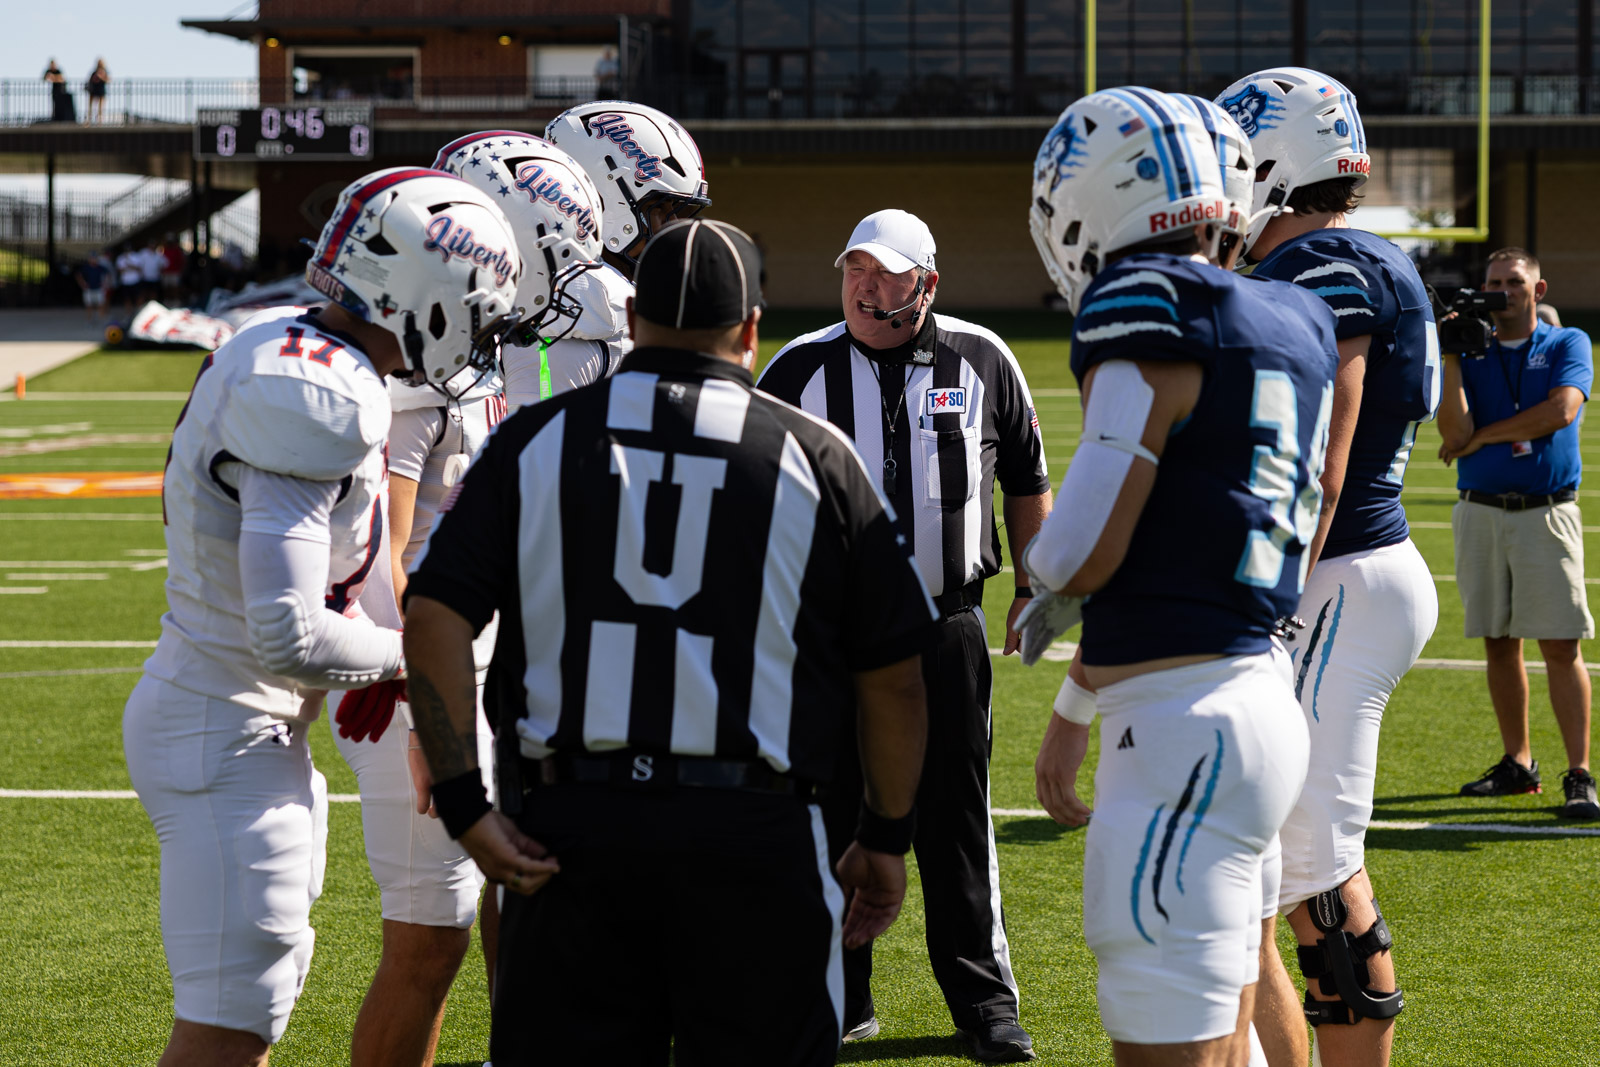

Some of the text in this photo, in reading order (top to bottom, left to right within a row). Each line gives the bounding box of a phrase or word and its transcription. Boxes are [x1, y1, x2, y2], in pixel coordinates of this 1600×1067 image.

[217, 125, 236, 156] 0
[350, 125, 370, 156] 0
[589, 114, 663, 182] Liberty
[515, 163, 597, 241] Liberty
[1150, 201, 1223, 233] Riddell
[424, 214, 512, 289] Liberty
[279, 326, 346, 368] 17
[609, 443, 728, 610] U
[632, 755, 653, 781] S
